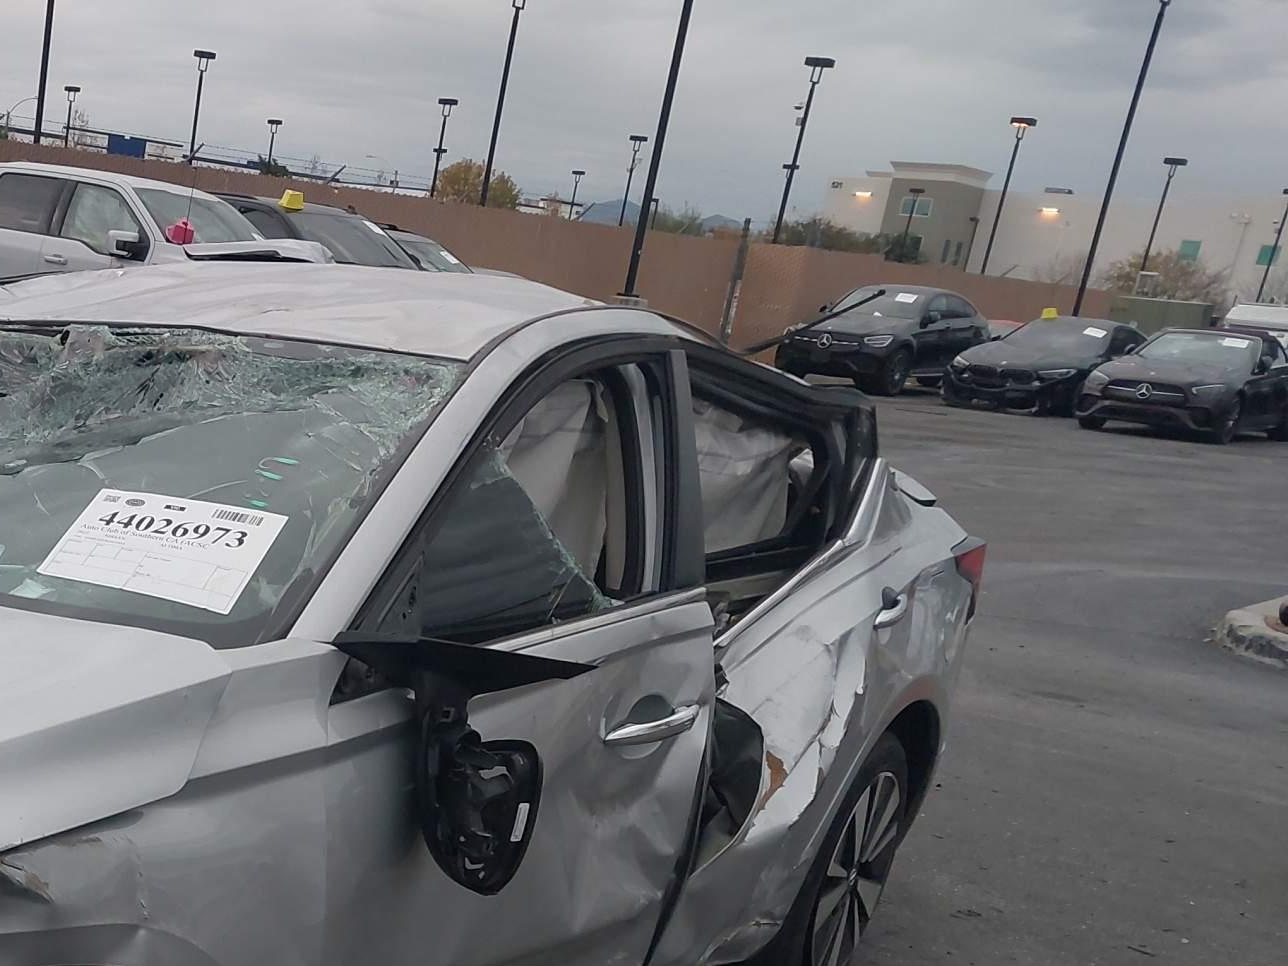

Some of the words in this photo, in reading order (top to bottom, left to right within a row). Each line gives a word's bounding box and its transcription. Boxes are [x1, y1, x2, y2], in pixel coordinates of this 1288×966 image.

[80, 523, 100, 531] Auto
[100, 526, 119, 534] Club
[130, 530, 165, 541] Southern
[98, 511, 248, 549] 44026973
